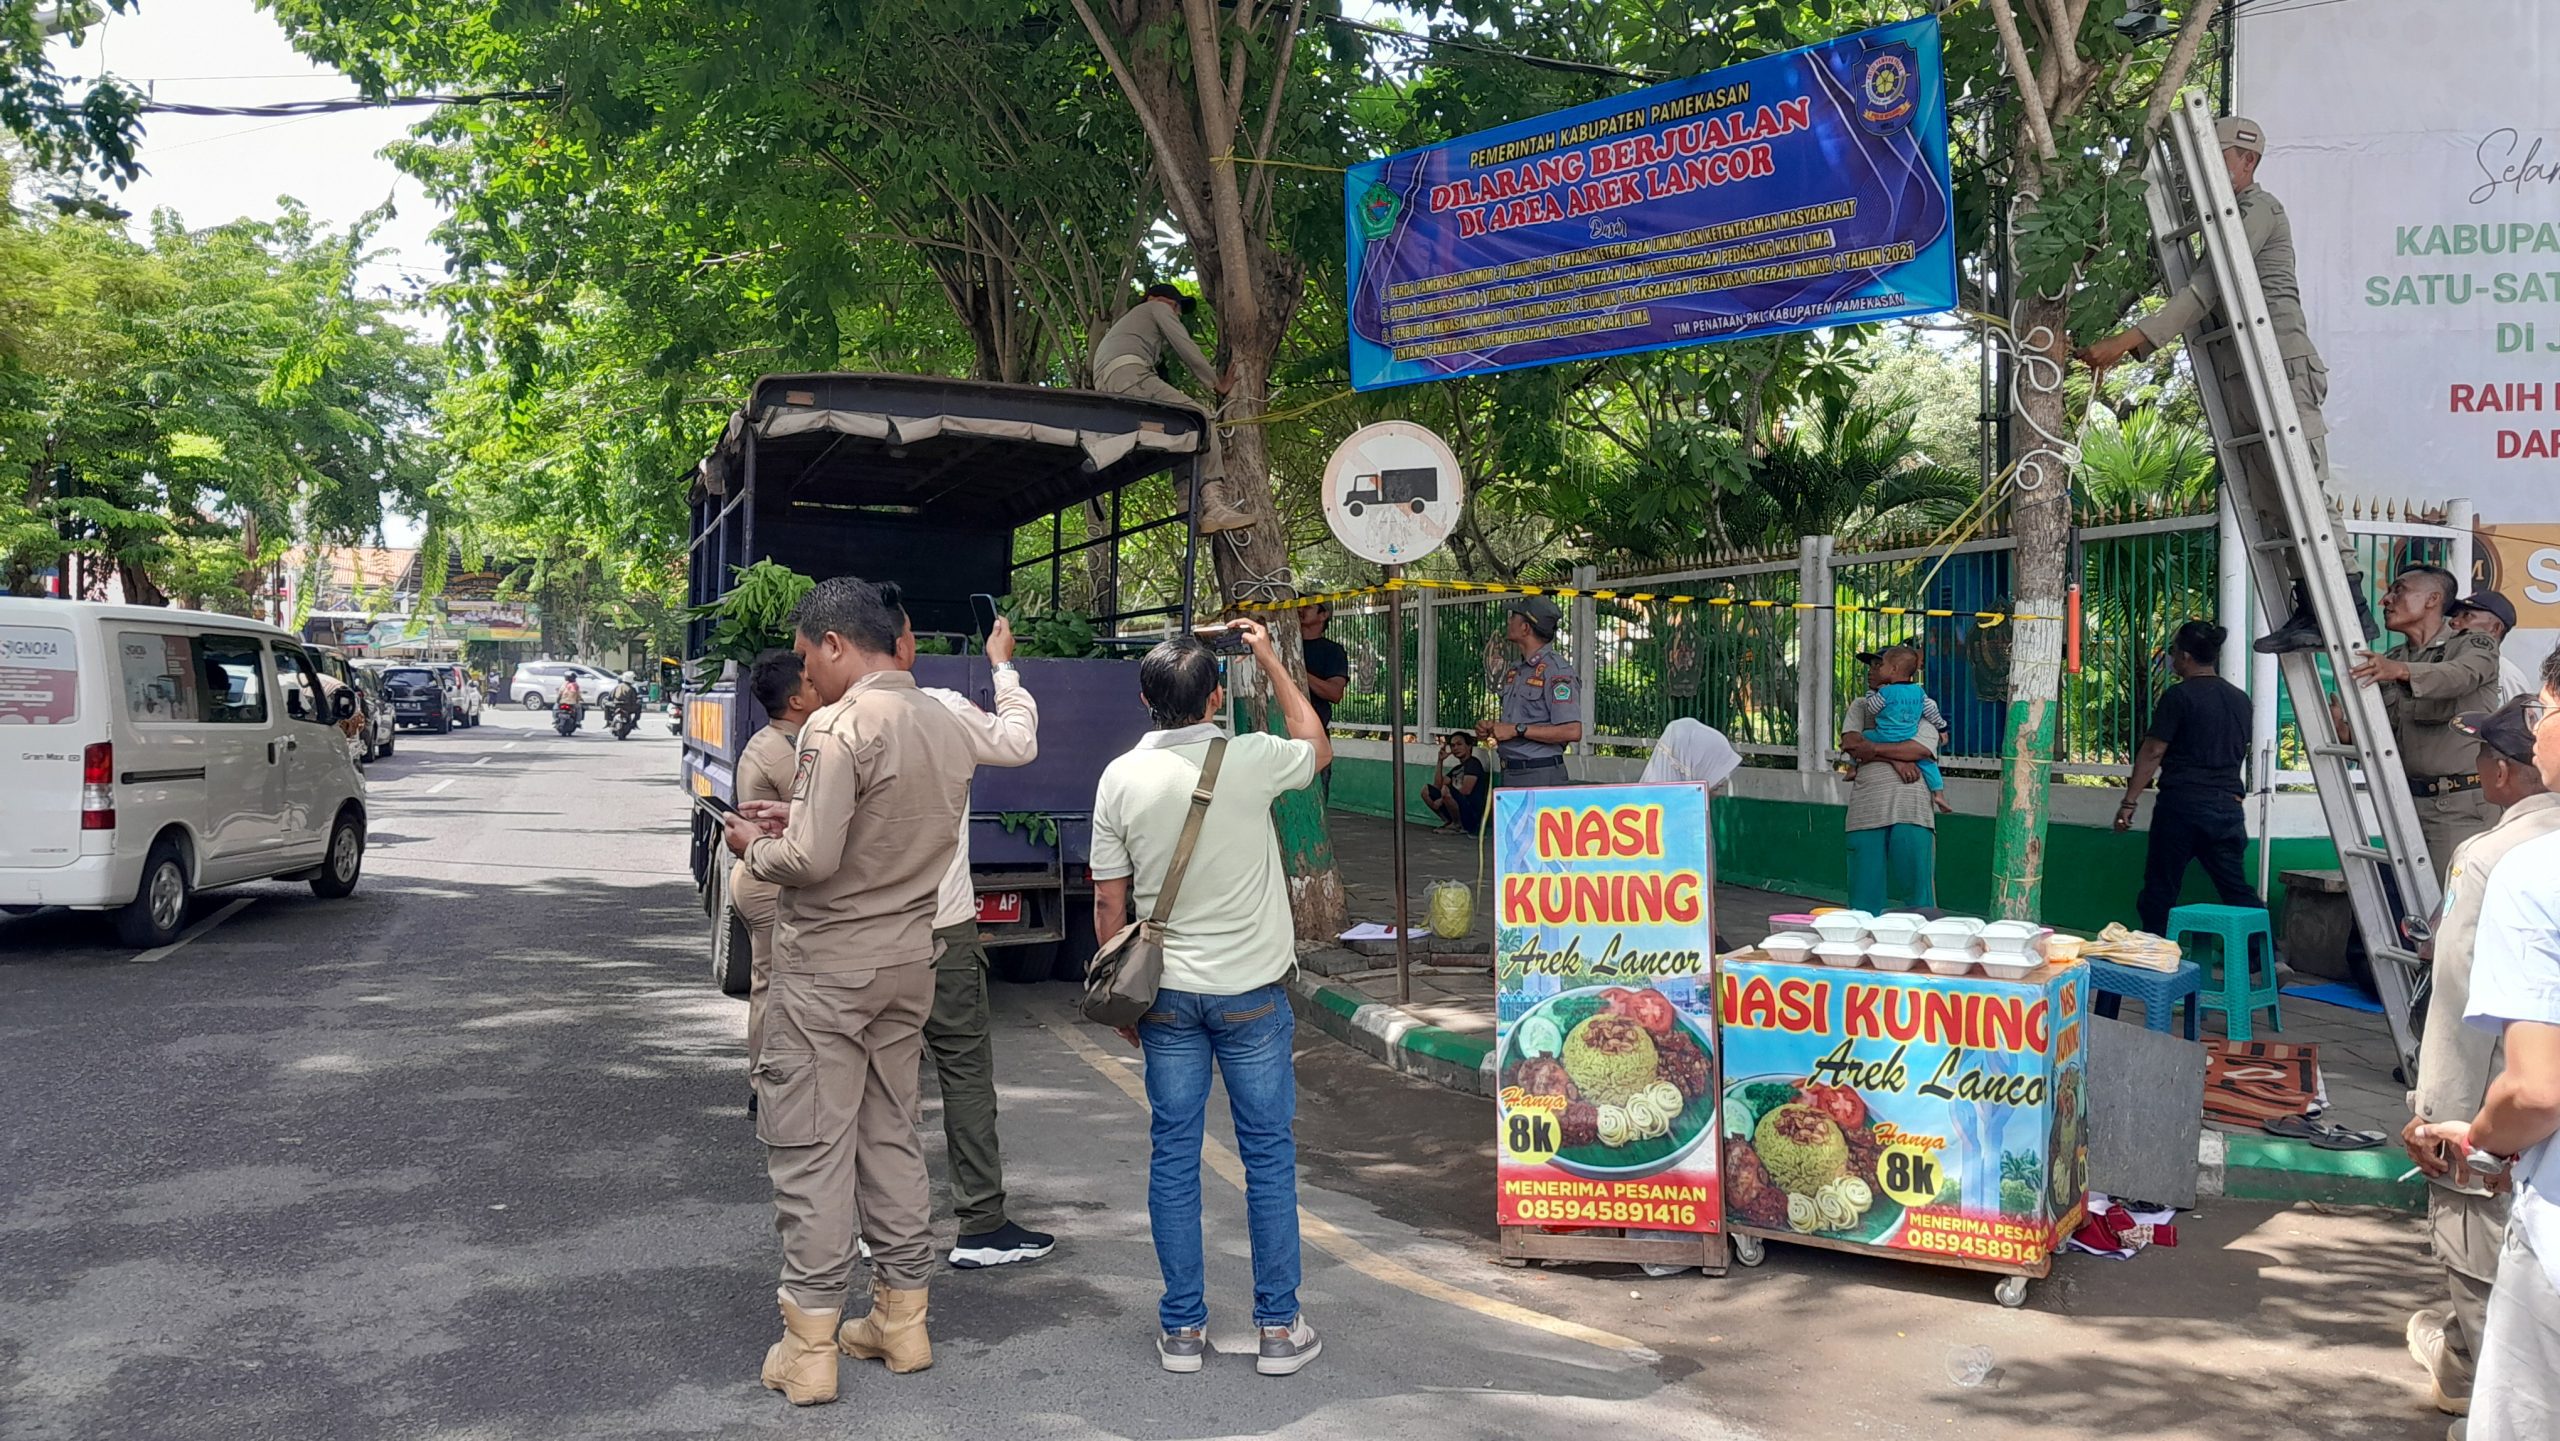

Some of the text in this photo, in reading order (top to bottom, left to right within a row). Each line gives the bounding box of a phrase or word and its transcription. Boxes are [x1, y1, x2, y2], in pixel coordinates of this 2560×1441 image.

[1469, 82, 1750, 169] PEMERINTAH KABUPATEN PAMEKASAN
[1430, 96, 1810, 212] DILARANG BERJUALAN
[1457, 144, 1774, 239] DI AREA AREK LANCOR
[1589, 216, 1626, 238] Dasar
[2396, 222, 2560, 256] KABUPA
[1390, 283, 1415, 299] PERDA
[1417, 274, 1464, 295] PAMEKASAN
[1465, 268, 1493, 286] NOMOR
[1504, 262, 1531, 278] TAHUN
[1532, 259, 1551, 273] 2019
[1554, 252, 1594, 269] TENTANG
[1594, 240, 1650, 260] KETERTIBAN
[1652, 235, 1682, 252] UMUM
[1684, 231, 1703, 247] DAN
[1704, 217, 1778, 242] KETENTRAMAN
[1779, 199, 1856, 224] MASYARAKAT
[1390, 303, 1415, 320] PERDA
[1417, 295, 1464, 316] PAMEKASAN
[1487, 285, 1512, 302] TAHUN
[1514, 282, 1537, 297] 2021
[1538, 276, 1574, 294] TENTANG
[1575, 267, 1621, 288] PENATAAN
[1624, 262, 1643, 278] DAN
[1645, 252, 1719, 276] PEMBERDAYAAN
[1721, 242, 1773, 265] PEDAGANG
[1775, 235, 1802, 254] KAKI
[1804, 231, 1831, 249] LIMA
[1424, 315, 1470, 336] PAMEKASAN
[1471, 311, 1501, 328] NOMOR
[1503, 307, 1517, 322] 101
[1519, 304, 1546, 319] TAHUN
[1547, 299, 1571, 314] 2022
[1573, 292, 1617, 312] PETUNJUK
[1619, 279, 1689, 304] PELAKSANAAN
[1691, 271, 1748, 293] PERATURAN
[1750, 263, 1792, 284] DAERAH
[1794, 258, 1832, 277] NOMOR
[1833, 256, 1842, 271] 4
[1844, 250, 1883, 269] TAHUN
[1884, 242, 1915, 262] 2021
[1393, 308, 1650, 361] TENTANG PENATAAN DAN PEMBERDAYAAN PEDAGANG KAKI LIMA
[1673, 320, 1690, 336] TIM
[1693, 314, 1743, 333] PENATAAN
[1768, 303, 1833, 325] KABUPATEN
[1835, 293, 1905, 313] PAMEKASAN
[2497, 322, 2534, 352] DI
[2450, 383, 2542, 412] RAIH
[1540, 809, 1659, 857] NASI
[999, 893, 1017, 911] AP
[1505, 874, 1698, 923] KUNING
[1502, 933, 1701, 977] Arek Lancor
[1723, 975, 1828, 1033] NASI
[1806, 1038, 1905, 1093] Arek
[1501, 1087, 1566, 1112] Hanya
[1509, 1115, 1553, 1153] 8k
[1873, 1123, 1946, 1152] Hanya
[1506, 1181, 1706, 1202] MENERIMA PESANAN
[1887, 1152, 1935, 1195] 8k
[1517, 1200, 1695, 1224] 085945891416
[1910, 1214, 1990, 1236] MENERIMA
